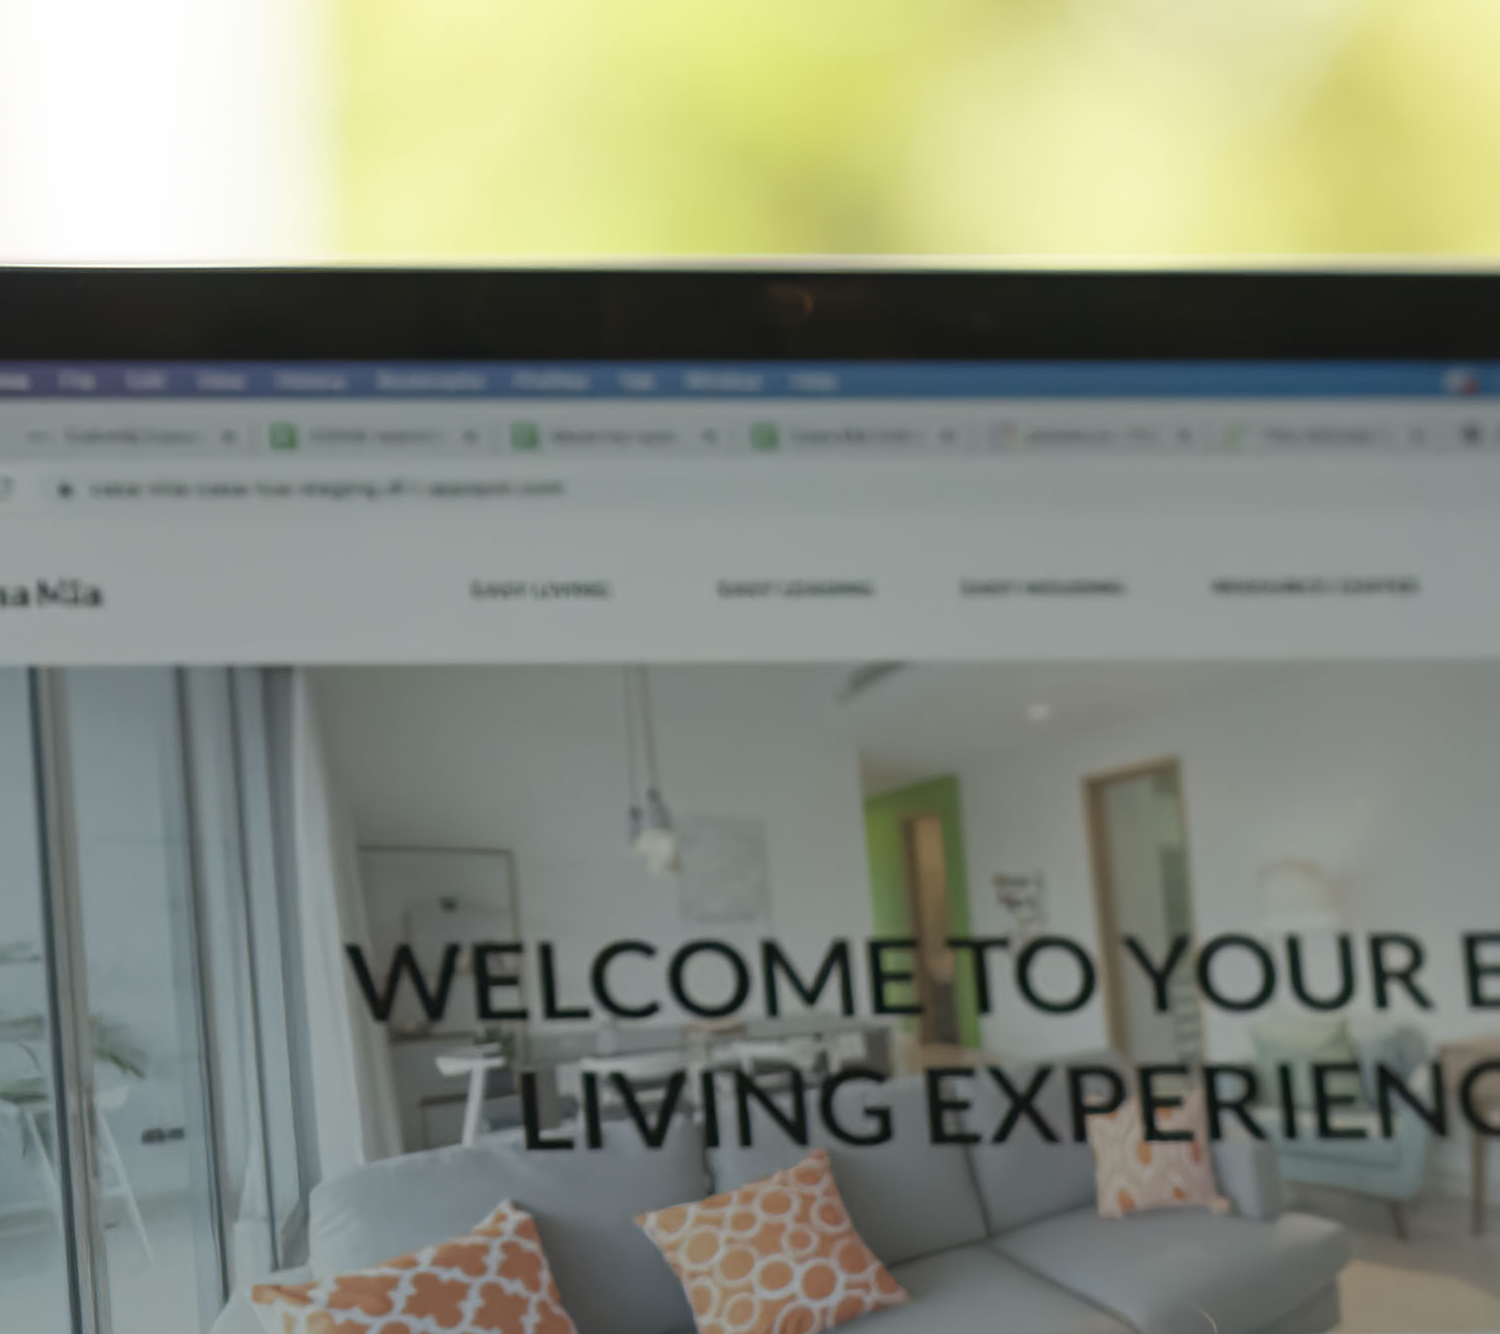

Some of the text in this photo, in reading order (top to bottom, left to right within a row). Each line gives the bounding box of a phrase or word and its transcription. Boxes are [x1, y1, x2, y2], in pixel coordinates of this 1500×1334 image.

[36, 577, 104, 609] Mia
[346, 934, 922, 1023] WELCOME
[951, 933, 1098, 1015] TO
[1121, 931, 1433, 1014] YOUR
[520, 1063, 894, 1151] LIVING
